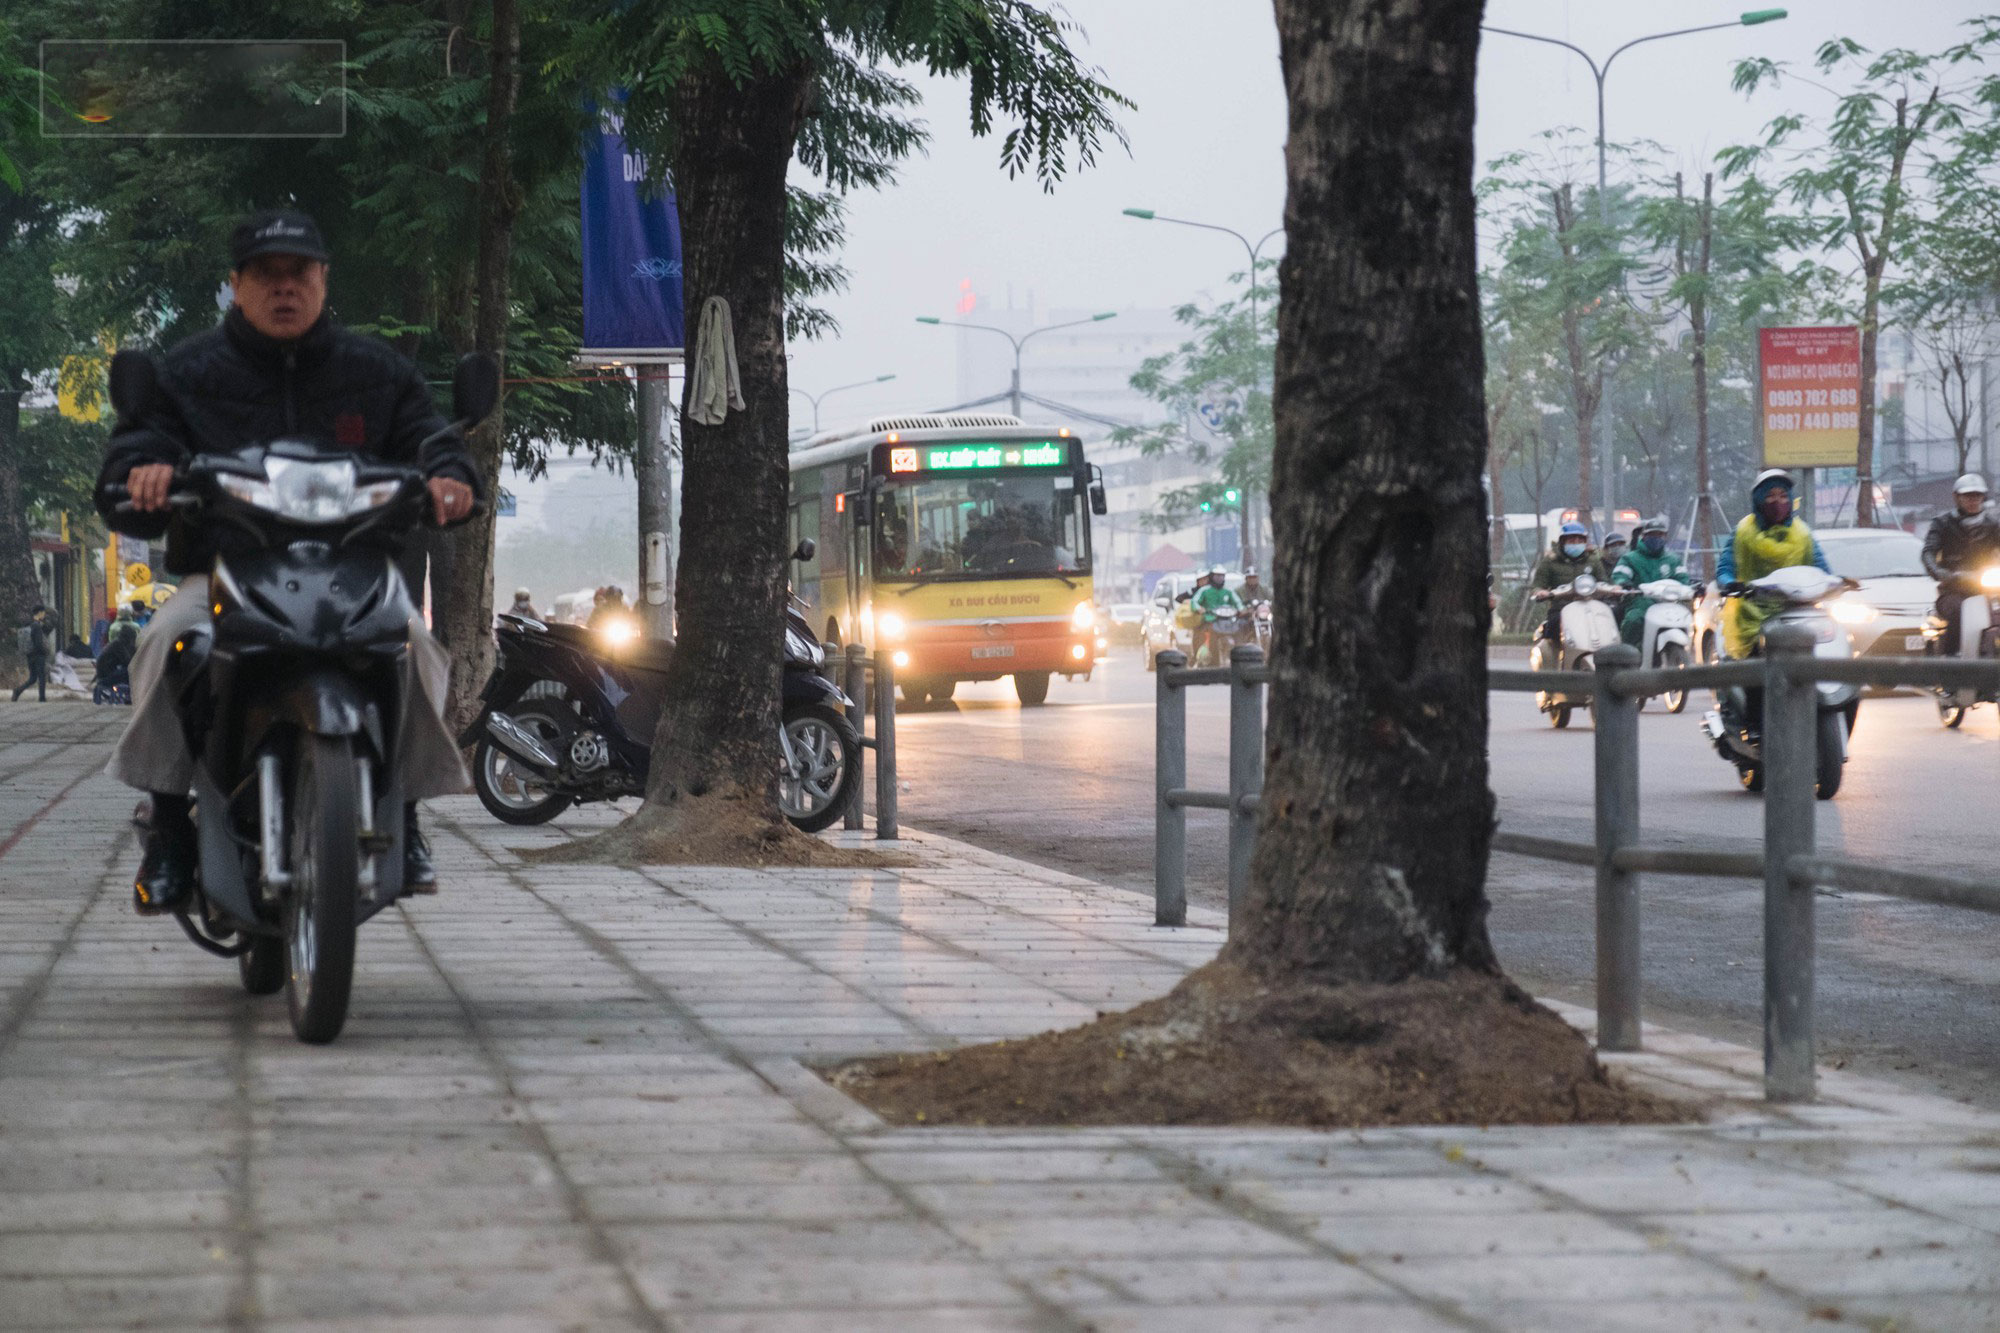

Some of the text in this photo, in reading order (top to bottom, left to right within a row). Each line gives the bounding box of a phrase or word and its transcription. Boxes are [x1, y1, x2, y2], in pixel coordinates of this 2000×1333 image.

[1768, 388, 1857, 407] 0903 702 689
[1768, 413, 1801, 430] 0987
[1804, 412, 1830, 429] 440
